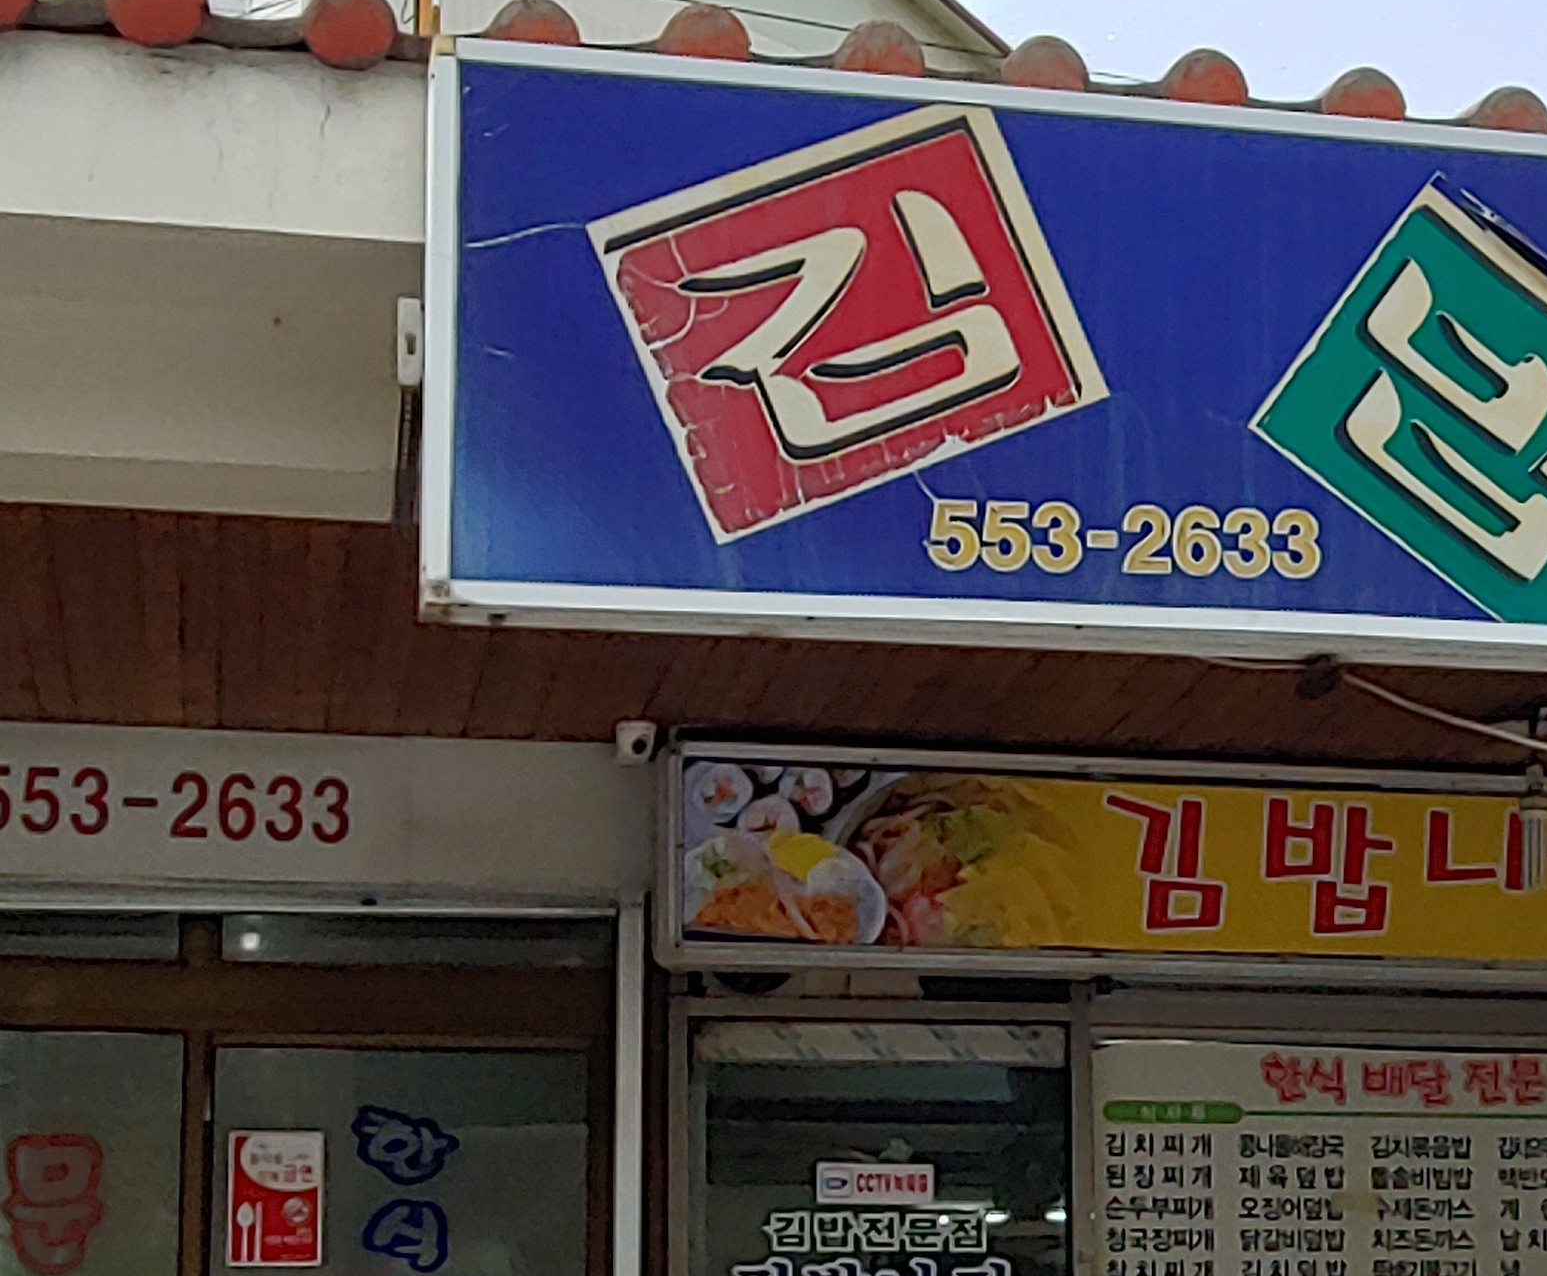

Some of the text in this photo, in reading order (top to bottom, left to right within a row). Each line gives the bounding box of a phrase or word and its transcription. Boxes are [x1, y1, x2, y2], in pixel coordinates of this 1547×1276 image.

[924, 496, 1324, 583] 553-2633
[1259, 1051, 1349, 1103] 한식
[1360, 1057, 1452, 1107] 배달
[1101, 1130, 1213, 1161] 김치찌개
[761, 1209, 988, 1254] 김밥전문점
